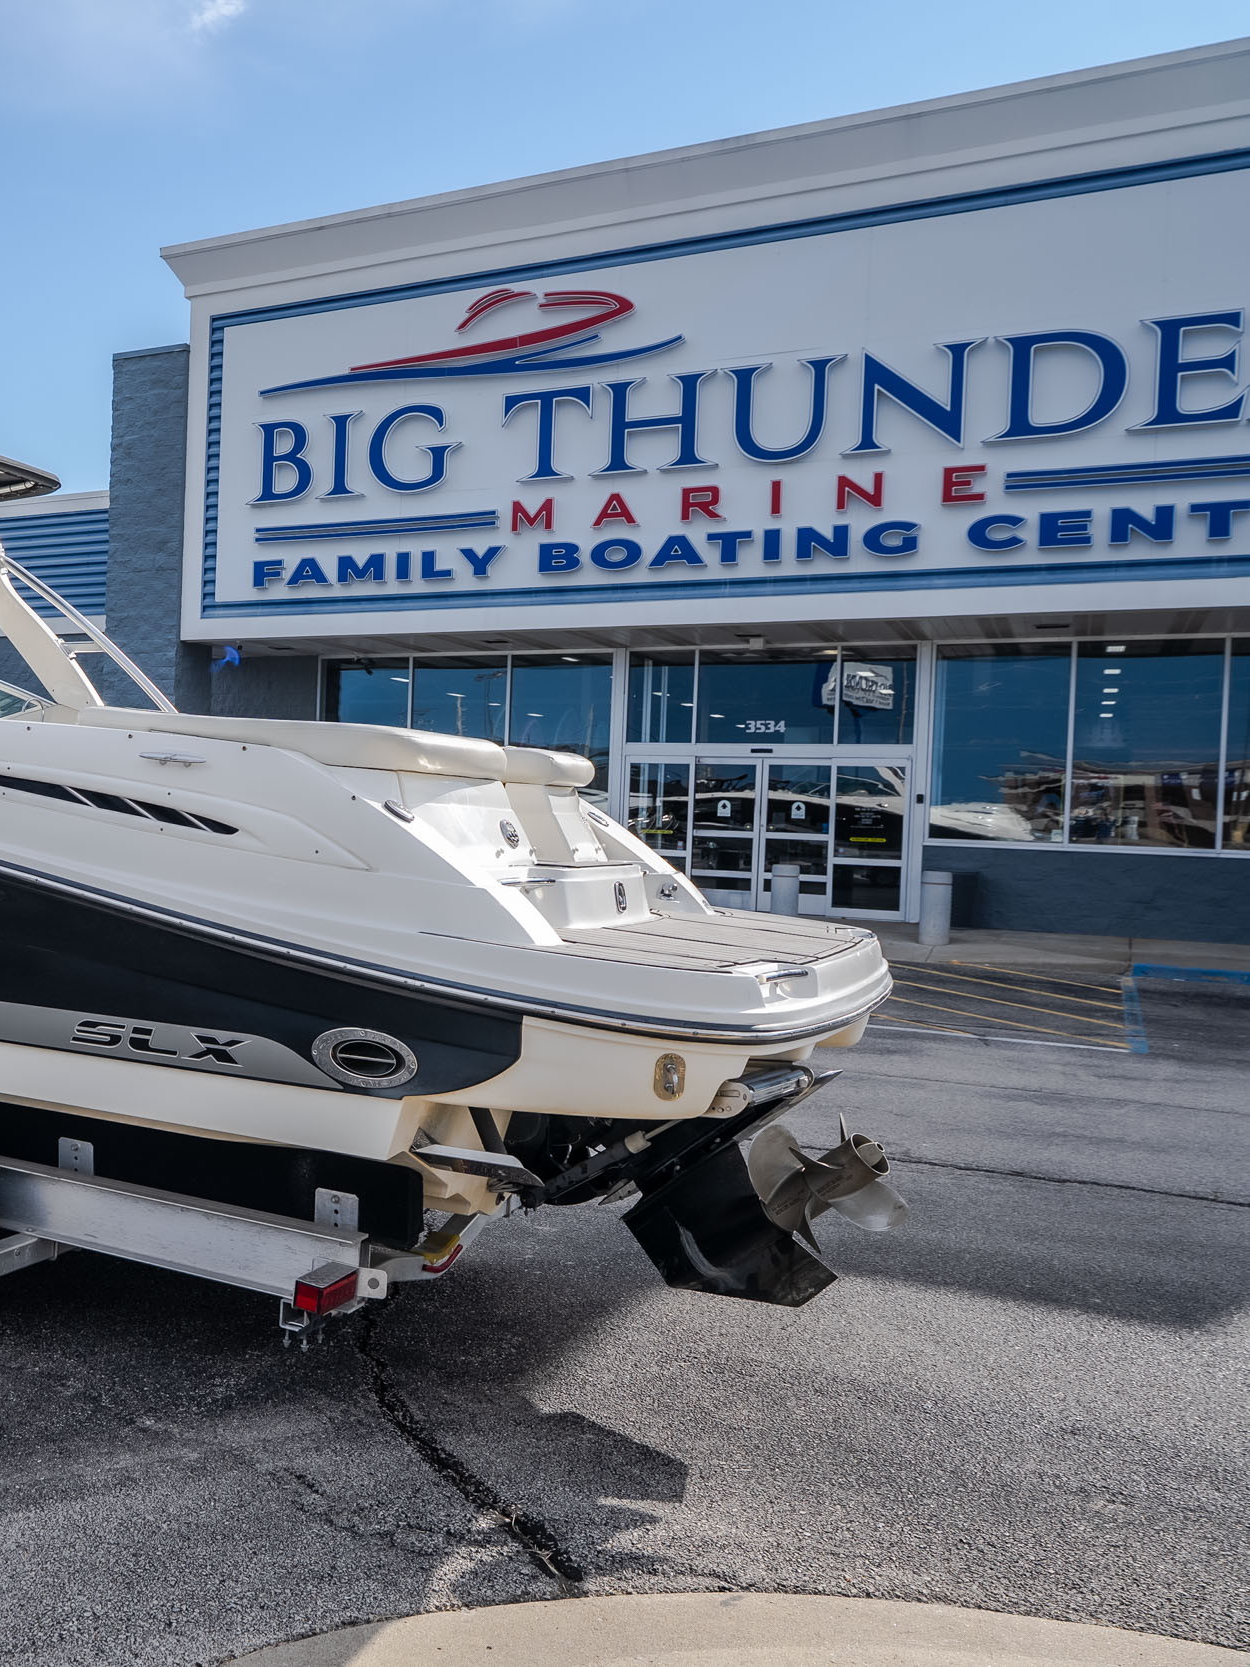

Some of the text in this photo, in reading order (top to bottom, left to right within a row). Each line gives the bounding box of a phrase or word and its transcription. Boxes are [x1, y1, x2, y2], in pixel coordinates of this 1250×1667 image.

[246, 307, 1250, 505] BIG THUNDE
[511, 464, 987, 534] MARINE
[252, 499, 1250, 588] FAMILY BOATING CENT
[745, 720, 786, 733] 3534
[69, 1018, 252, 1068] SLX
